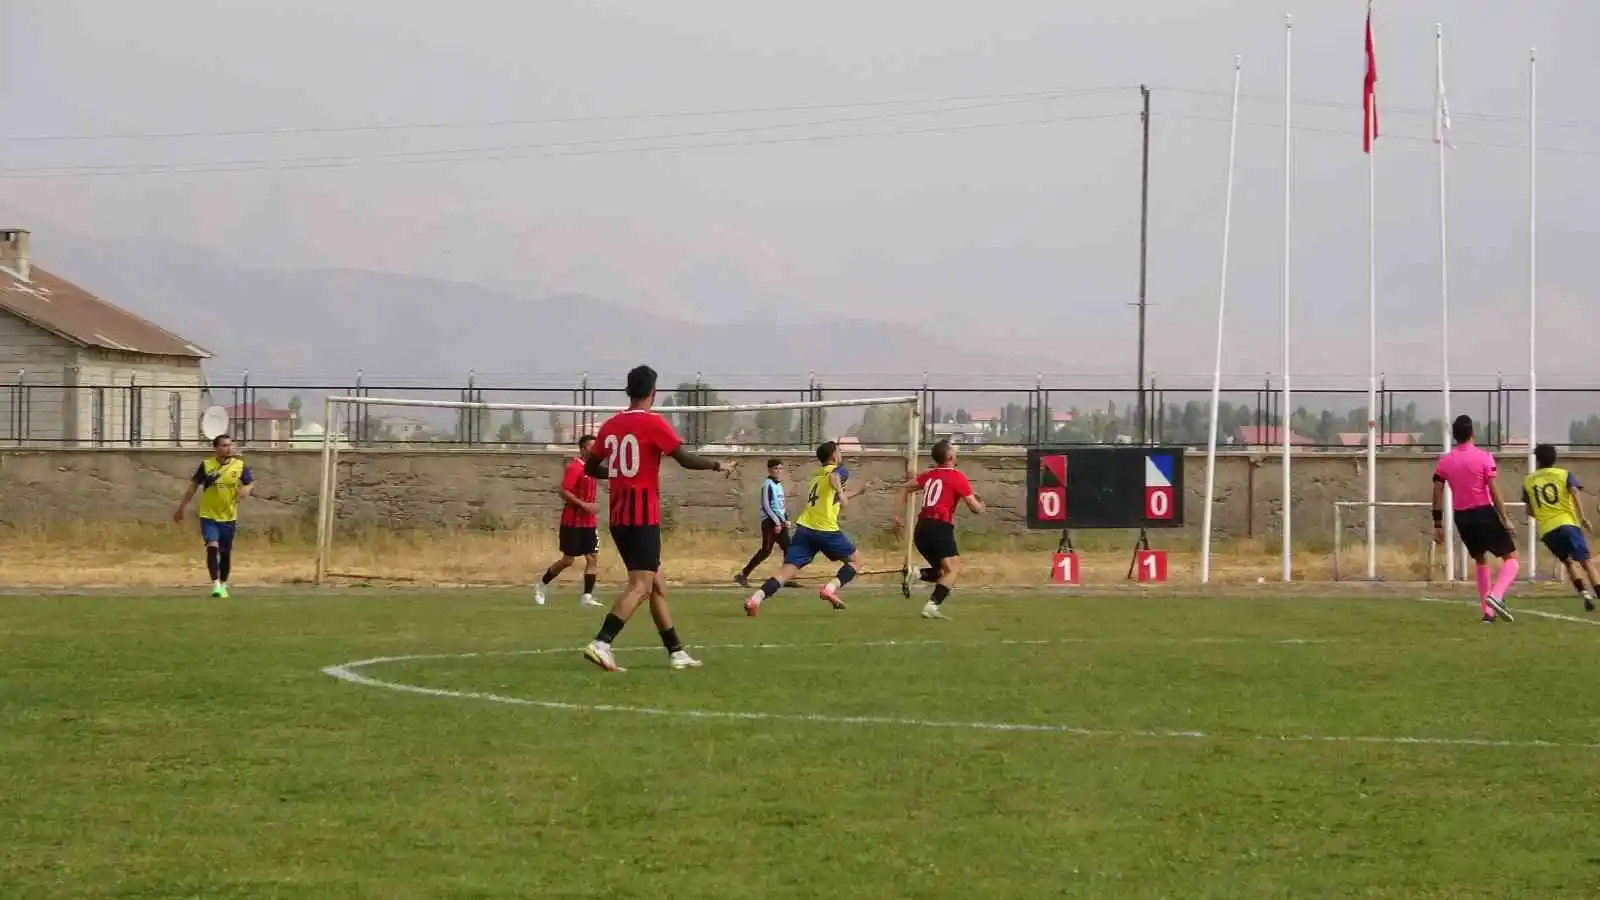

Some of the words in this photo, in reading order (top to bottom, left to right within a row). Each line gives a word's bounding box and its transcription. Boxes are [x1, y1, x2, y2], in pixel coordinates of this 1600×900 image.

[604, 434, 640, 478] 20
[807, 483, 819, 507] 4
[921, 477, 943, 507] 10
[1041, 491, 1061, 516] 0
[1150, 490, 1168, 516] 0
[1532, 482, 1558, 508] 10
[1057, 557, 1072, 581] 1
[1143, 555, 1157, 580] 1
